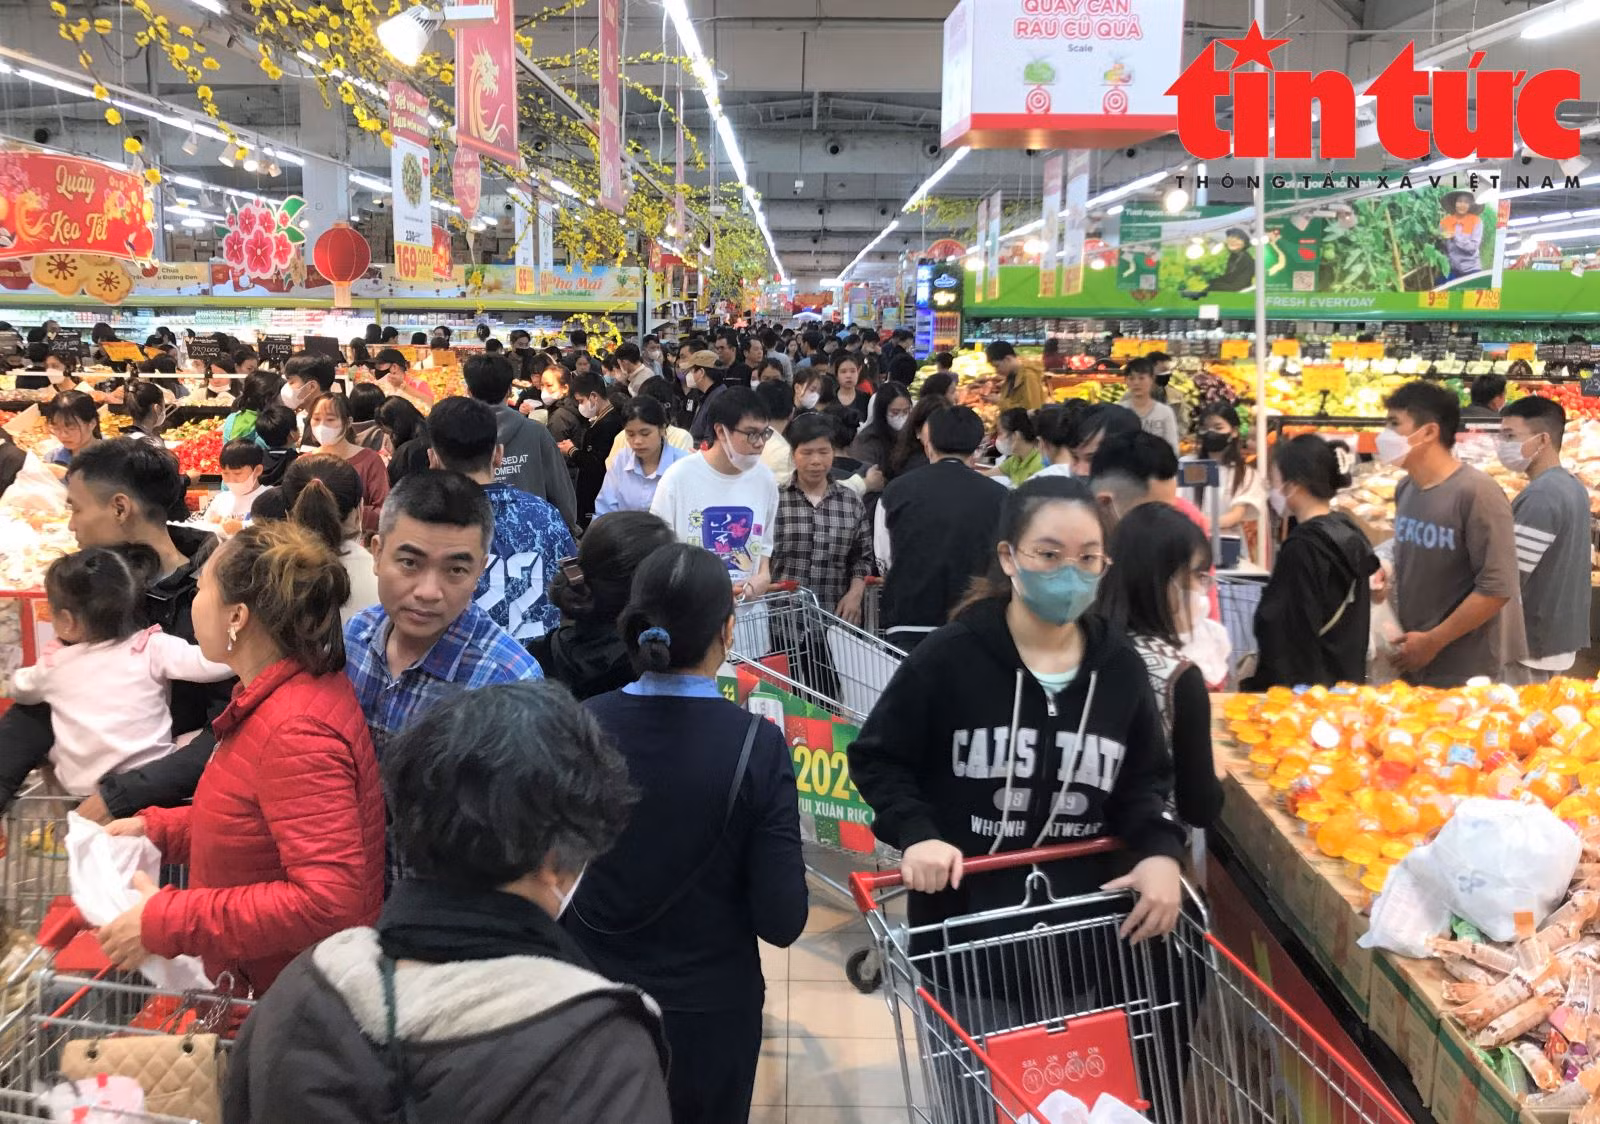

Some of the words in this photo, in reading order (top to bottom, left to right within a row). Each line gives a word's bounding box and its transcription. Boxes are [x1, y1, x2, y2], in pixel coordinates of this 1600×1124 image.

[1016, 20, 1058, 38] RAU
[1062, 15, 1091, 38] CỦ
[1097, 15, 1142, 38] QUẢ
[1067, 44, 1093, 52] Scale
[56, 165, 96, 203] Quầy
[50, 210, 81, 245] Kẹo
[86, 212, 108, 243] Tết
[1264, 297, 1304, 306] FRESH
[1310, 298, 1376, 307] EVERYDAY
[501, 456, 518, 465] SED
[519, 454, 528, 463] AT
[495, 465, 521, 475] OMENT
[794, 745, 866, 803] 202
